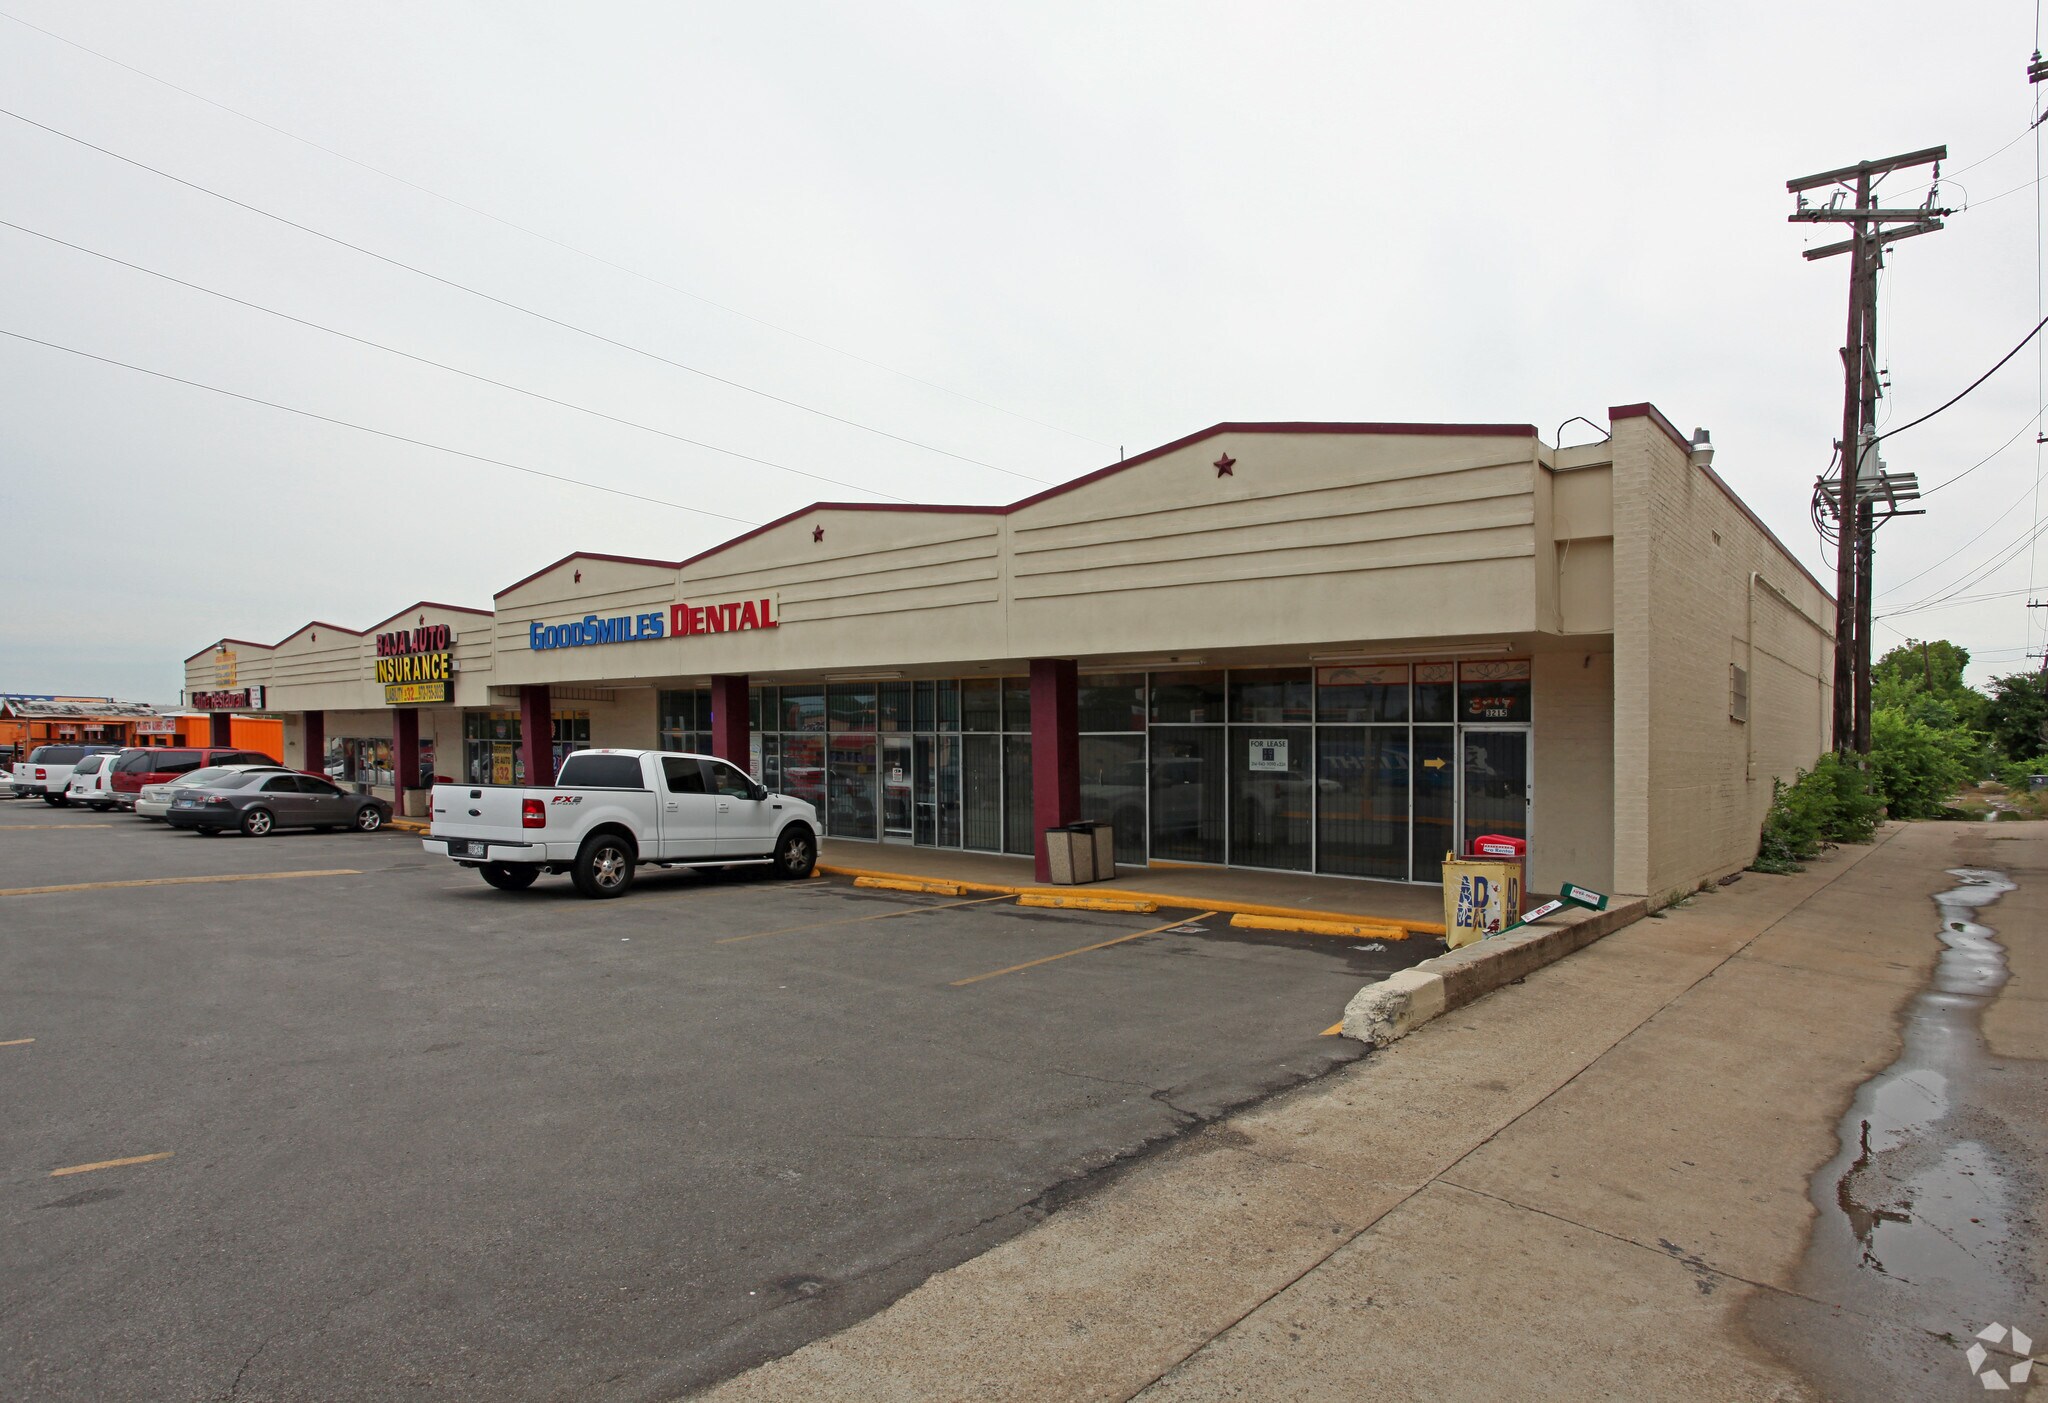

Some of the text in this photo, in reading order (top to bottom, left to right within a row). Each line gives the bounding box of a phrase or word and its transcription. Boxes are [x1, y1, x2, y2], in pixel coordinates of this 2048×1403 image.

[670, 599, 777, 637] DENTAL
[376, 624, 448, 657] BAJA AUTO
[375, 653, 450, 683] INSURANCE
[1485, 708, 1508, 717] 3215
[1250, 740, 1286, 748] FOR LEASE
[551, 795, 583, 803] FX2
[1458, 875, 1489, 908] AD
[1507, 876, 1518, 909] AD
